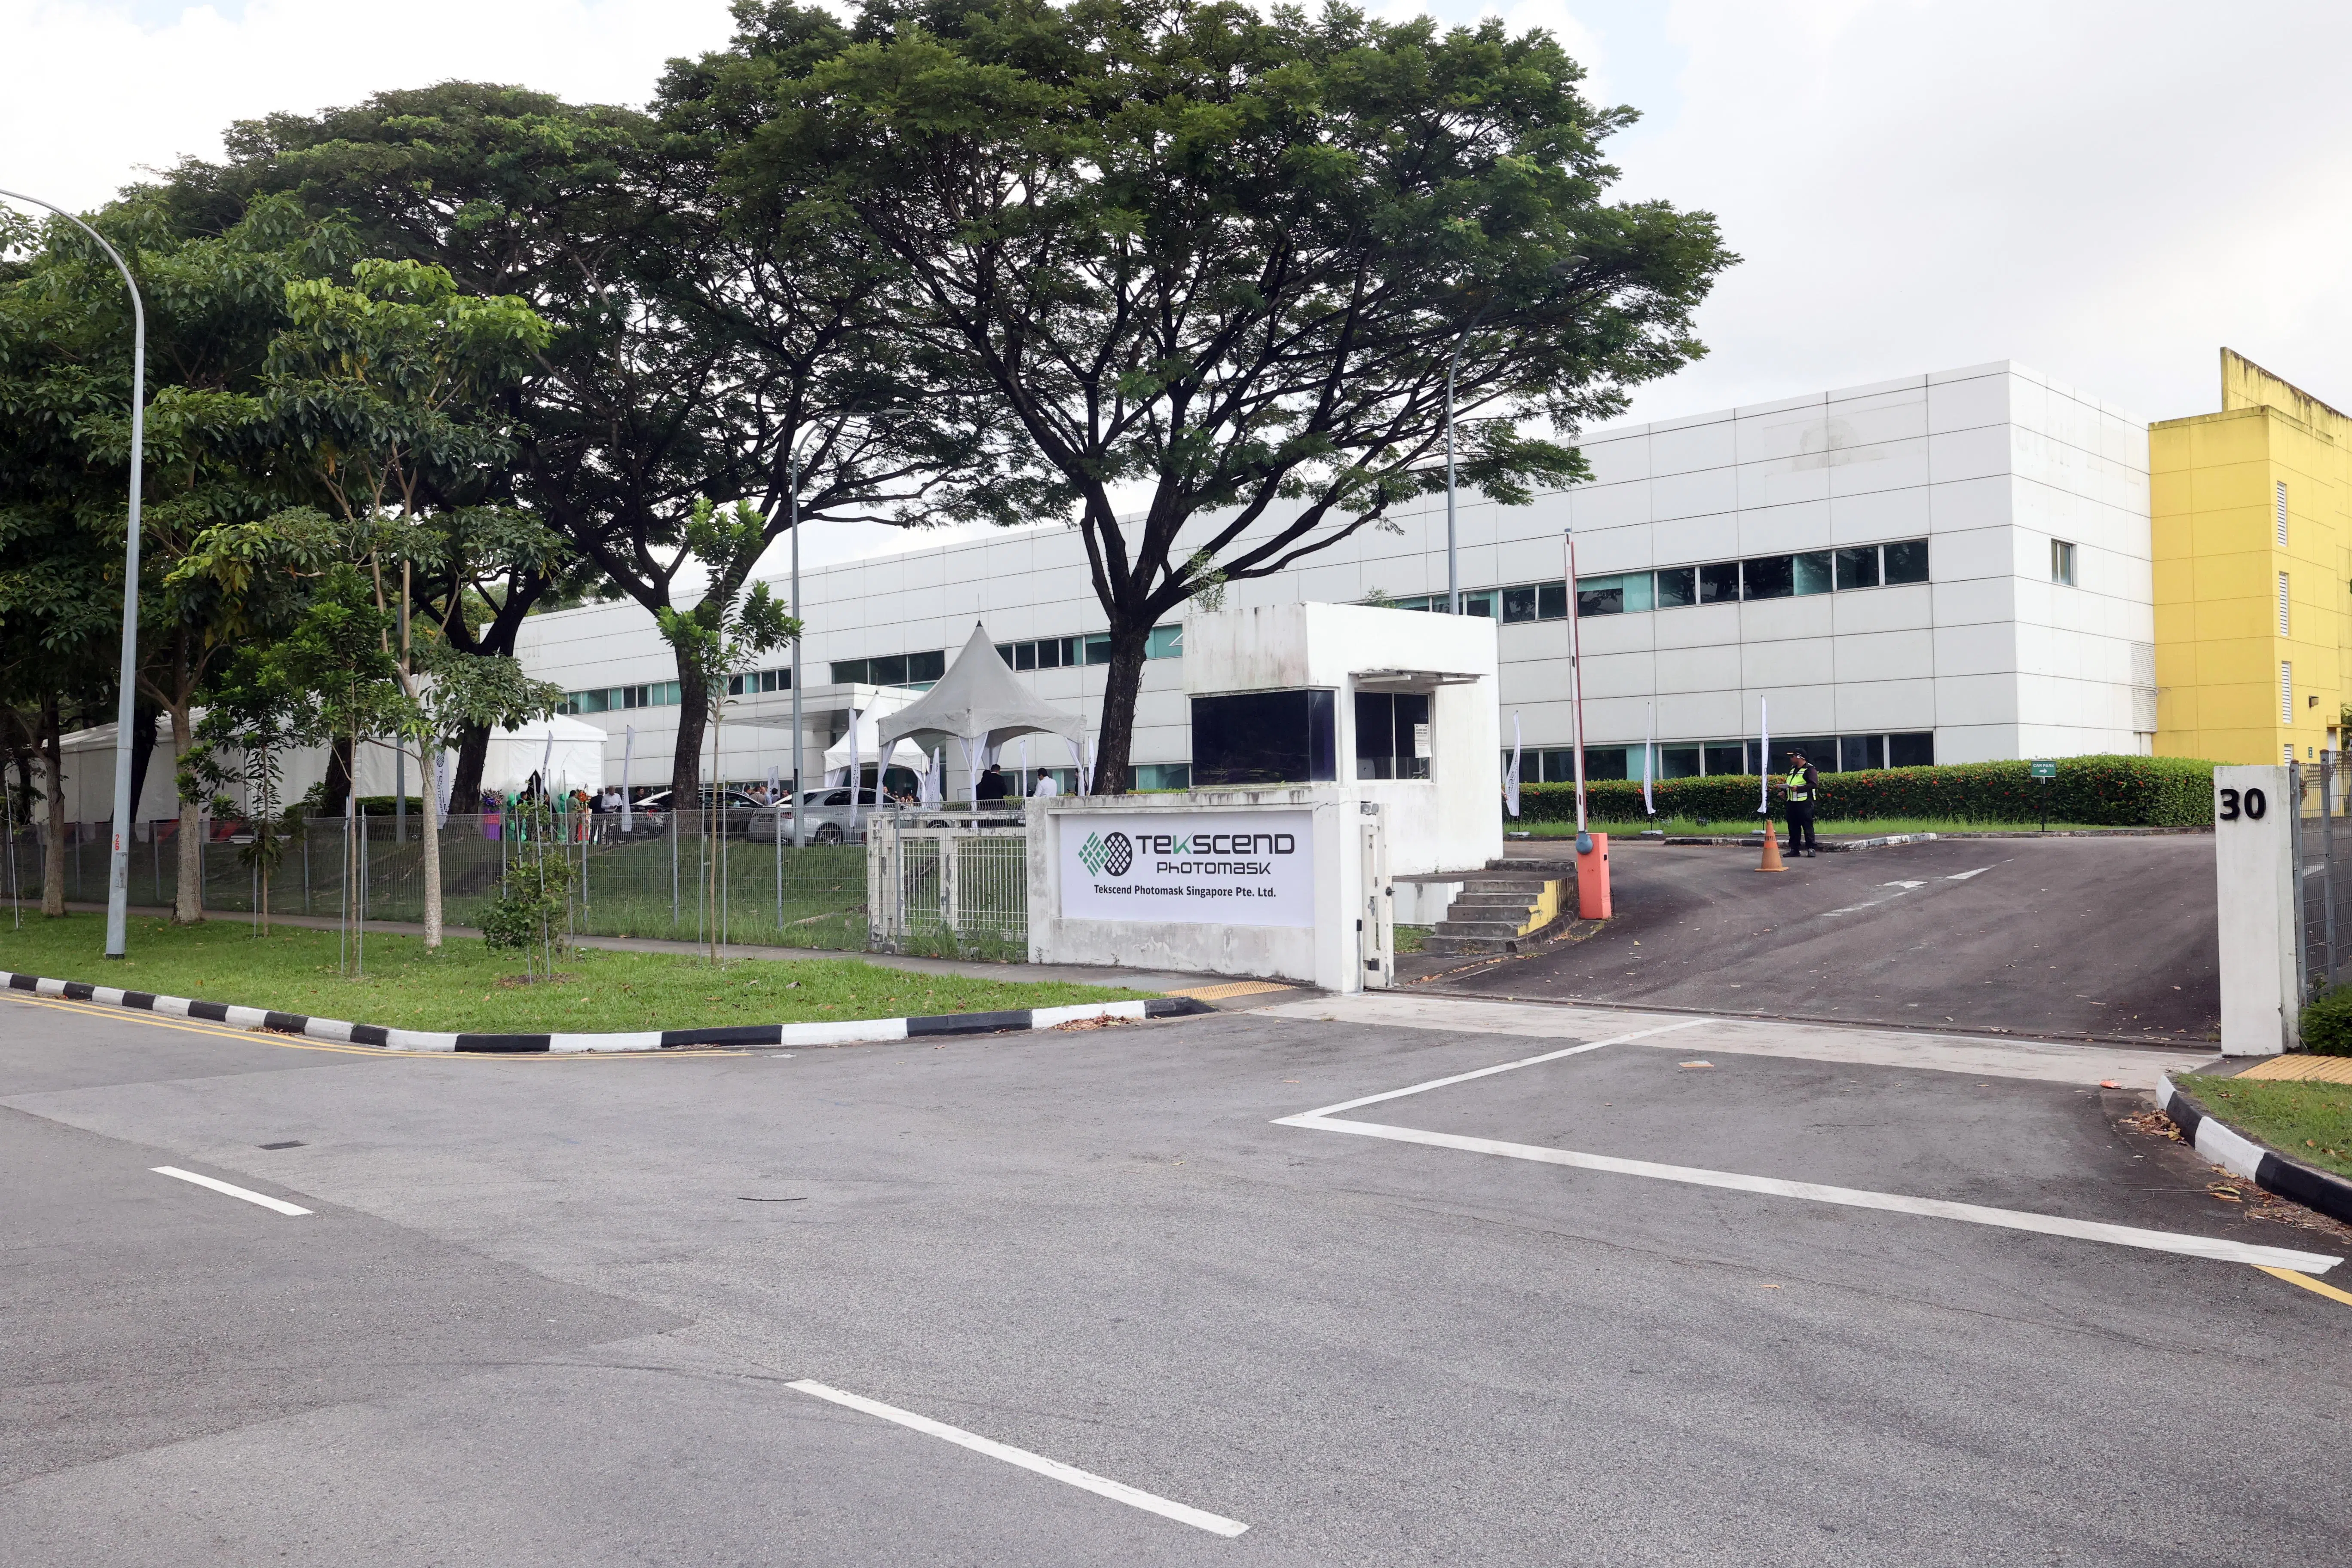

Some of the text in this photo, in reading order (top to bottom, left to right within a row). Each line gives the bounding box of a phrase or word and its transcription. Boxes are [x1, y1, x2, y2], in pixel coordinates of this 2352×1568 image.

[2220, 788, 2266, 820] 30
[1094, 884, 1276, 898] Tekscend Photomask Singapore Pte. Ltd.
